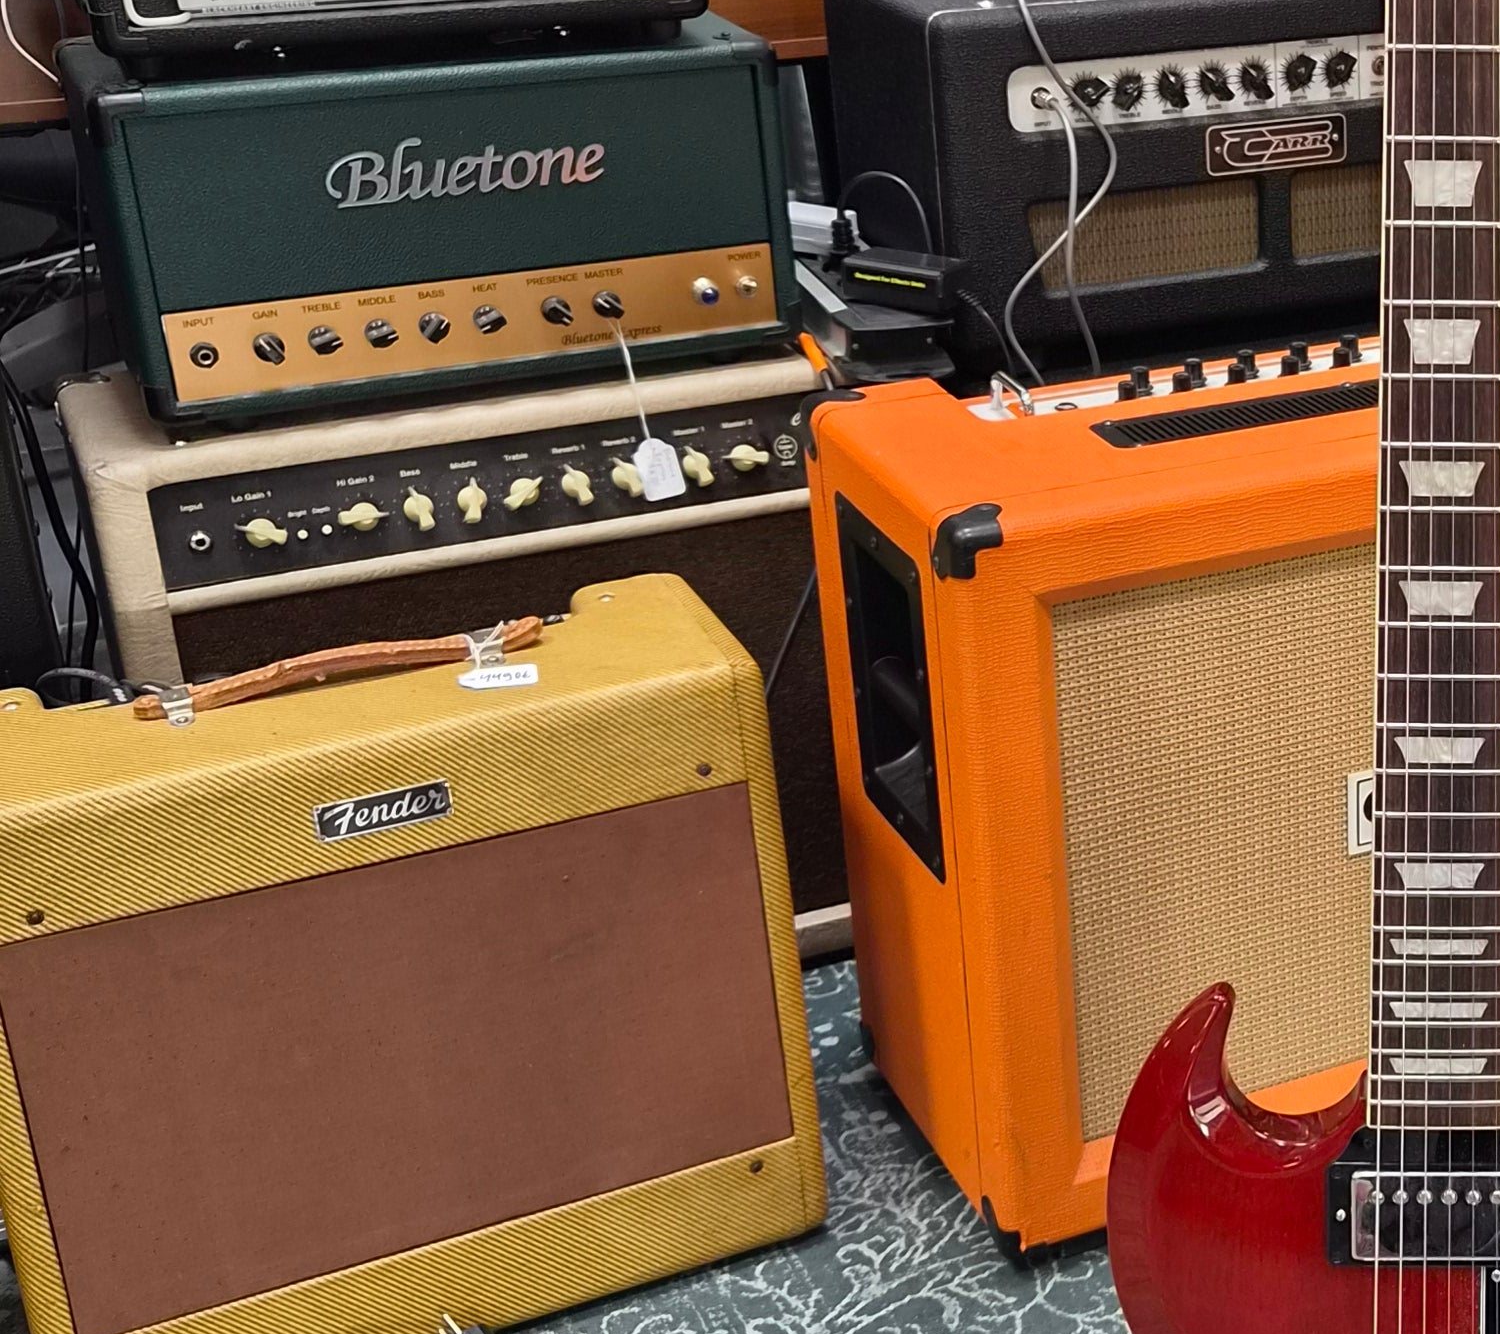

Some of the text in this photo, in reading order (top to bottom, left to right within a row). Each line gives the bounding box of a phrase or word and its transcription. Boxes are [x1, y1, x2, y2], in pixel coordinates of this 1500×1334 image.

[1220, 120, 1333, 167] CARR
[325, 137, 605, 209] Bluetone
[727, 250, 762, 262] POWER
[526, 272, 579, 286] PRESENCE
[584, 268, 623, 280] MASTER
[472, 282, 498, 293] HEAT
[357, 294, 397, 307] MIDDLE
[417, 289, 445, 300] BASS
[301, 301, 342, 314] TREBLE
[251, 309, 279, 320] GAIN
[182, 316, 215, 329] INPUT
[561, 329, 614, 347] Bluetone
[348, 476, 368, 486] Gain
[230, 493, 242, 503] Lo
[244, 491, 265, 502] Gain
[179, 502, 204, 513] Input
[322, 788, 446, 836] Fender
